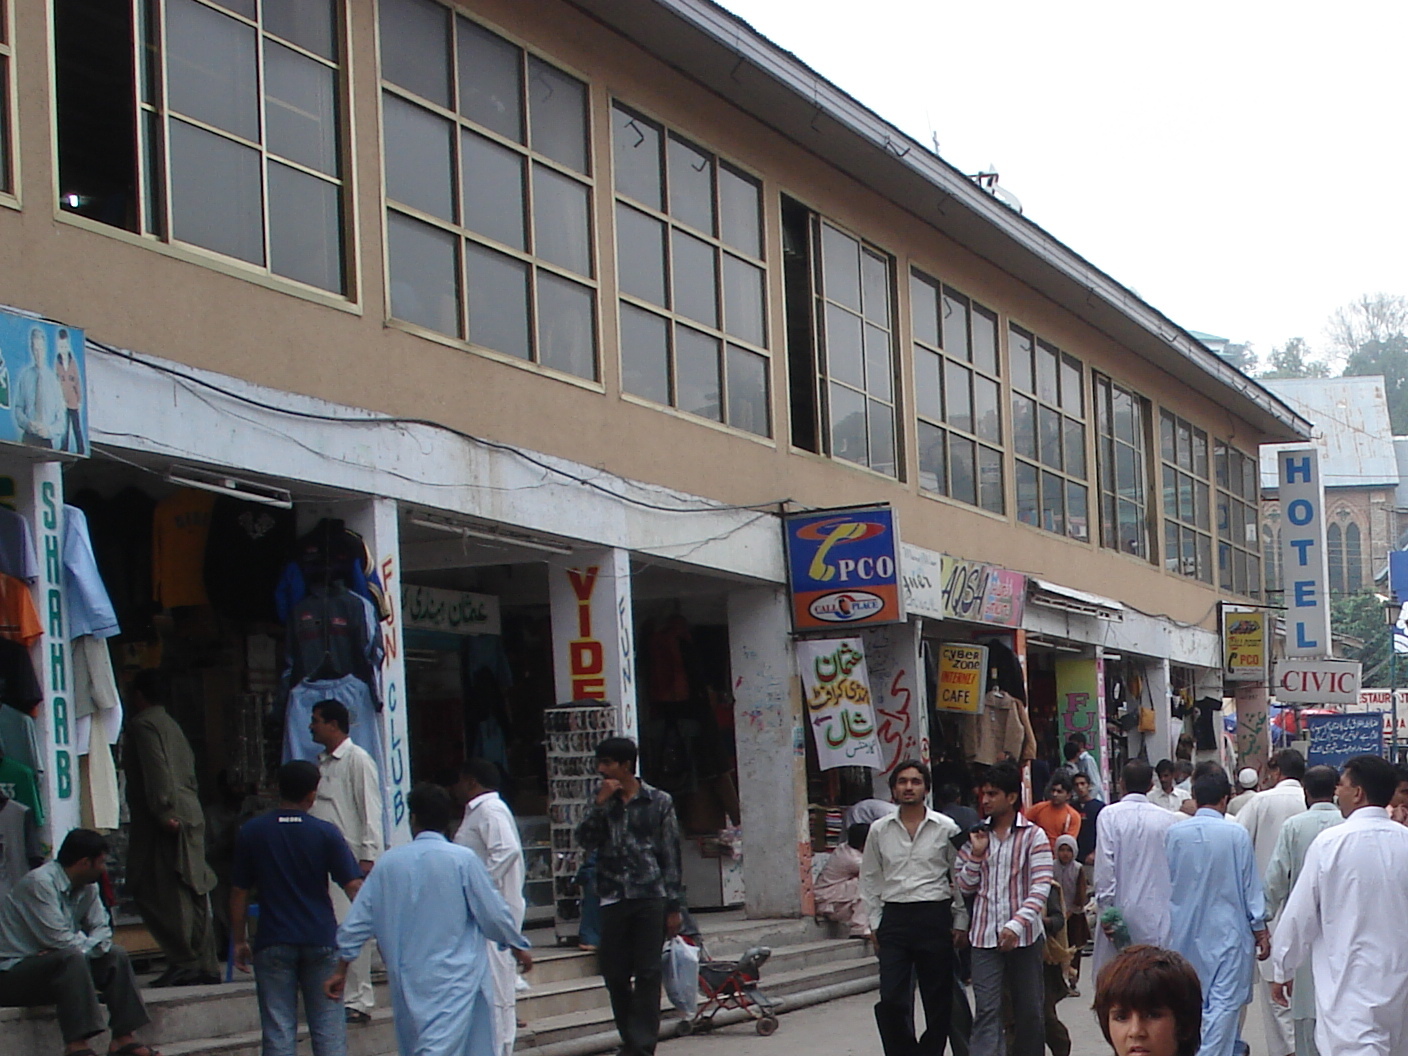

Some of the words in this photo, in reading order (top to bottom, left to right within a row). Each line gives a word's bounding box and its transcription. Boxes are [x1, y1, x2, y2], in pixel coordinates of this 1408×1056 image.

[838, 555, 894, 581] PCO
[1286, 456, 1318, 649] HOTEL
[814, 604, 838, 613] CALL
[851, 601, 879, 611] PLACE
[941, 565, 990, 616] AQSA
[41, 481, 72, 800] SHAHAB
[566, 566, 606, 700] VIDE
[815, 641, 864, 683] عثمان
[1240, 654, 1260, 666] PCO
[942, 688, 971, 704] CAFE
[1282, 669, 1355, 695] CIVIC
[825, 709, 874, 750] شال
